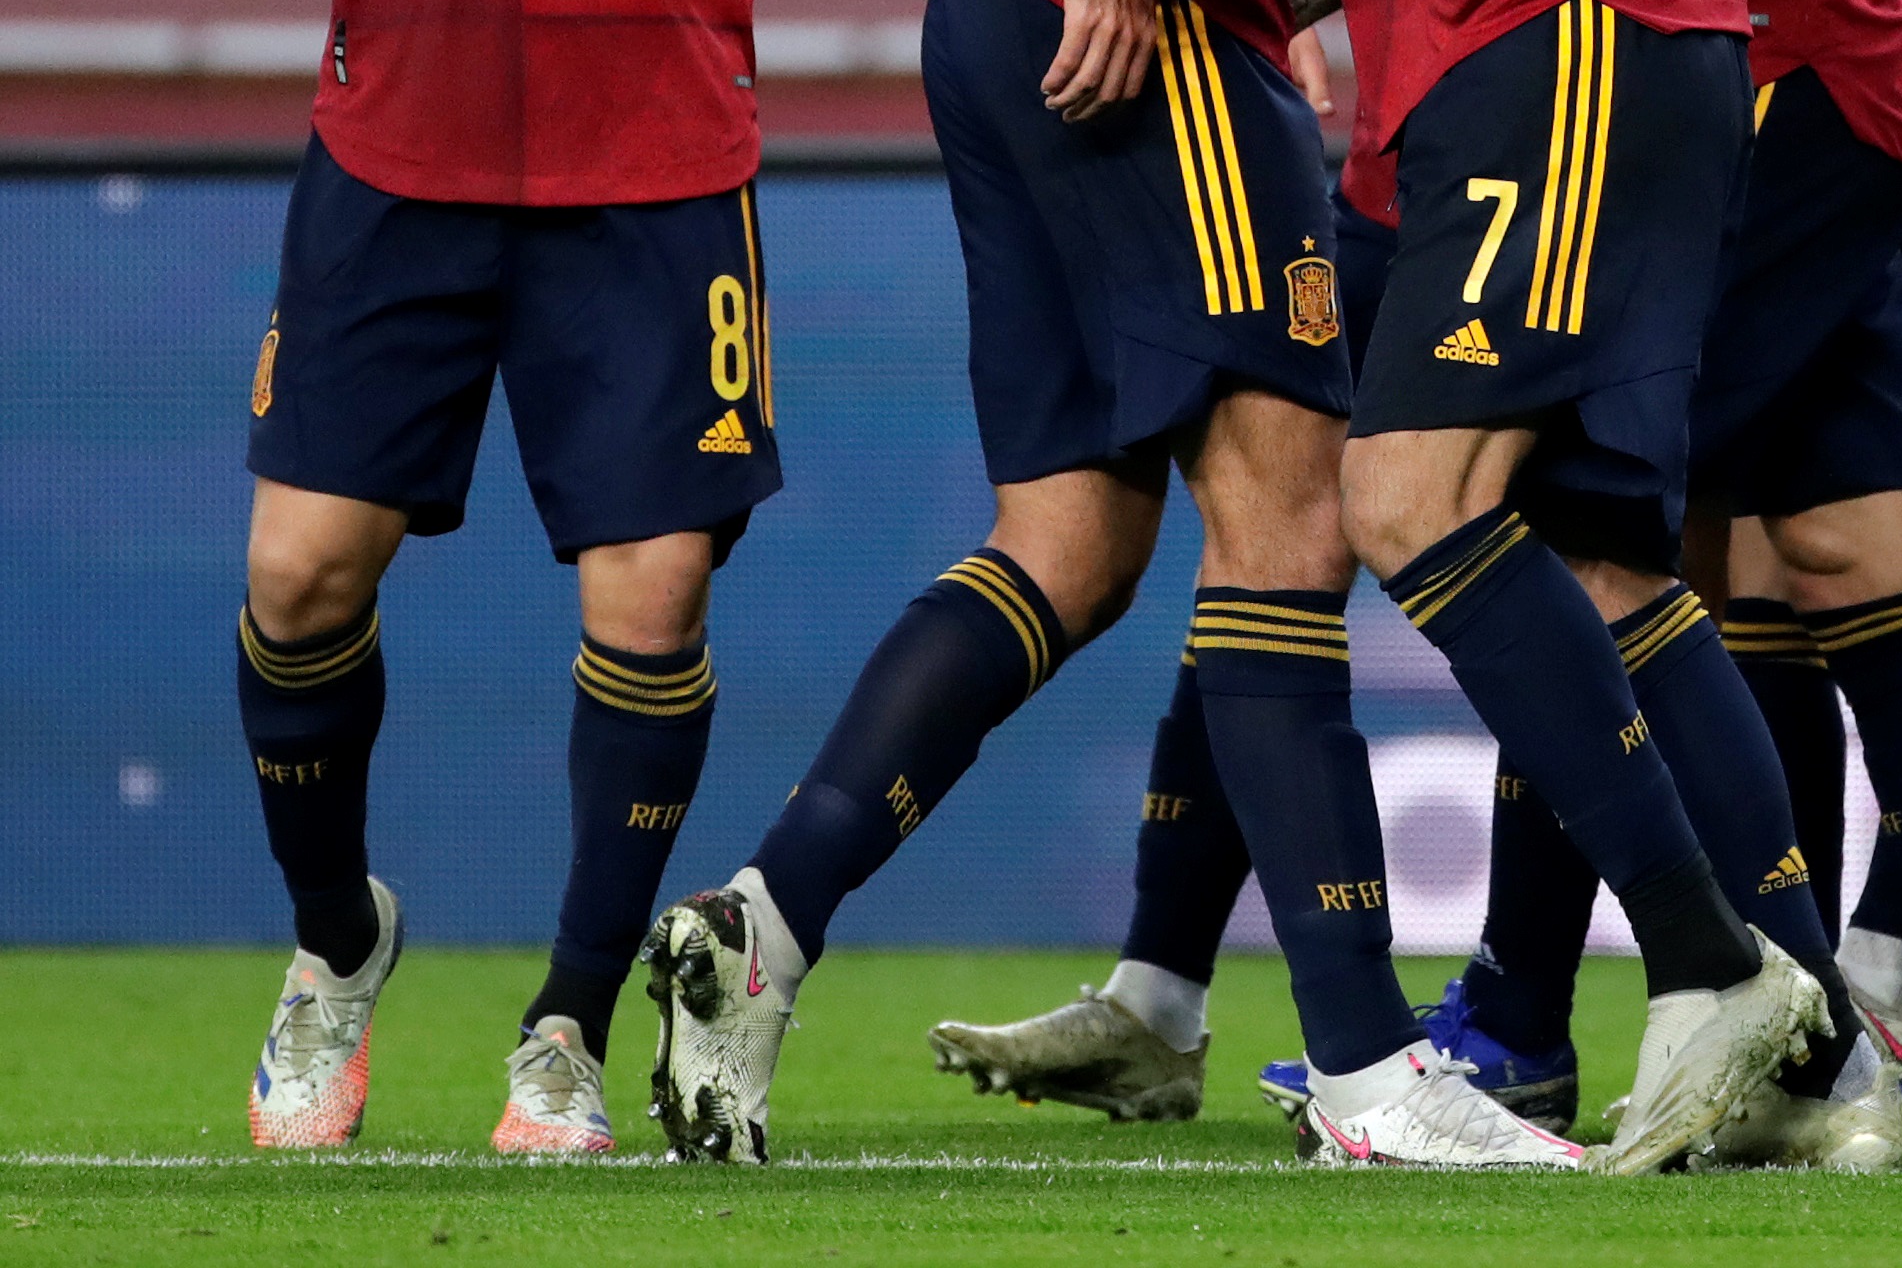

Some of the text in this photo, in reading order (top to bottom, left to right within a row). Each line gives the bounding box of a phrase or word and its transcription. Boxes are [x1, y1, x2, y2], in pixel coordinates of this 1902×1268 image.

[1466, 177, 1518, 304] 7
[707, 274, 749, 401] 8
[1433, 343, 1500, 367] adidas
[697, 436, 753, 455] adidas
[1317, 880, 1382, 911] RFEF
